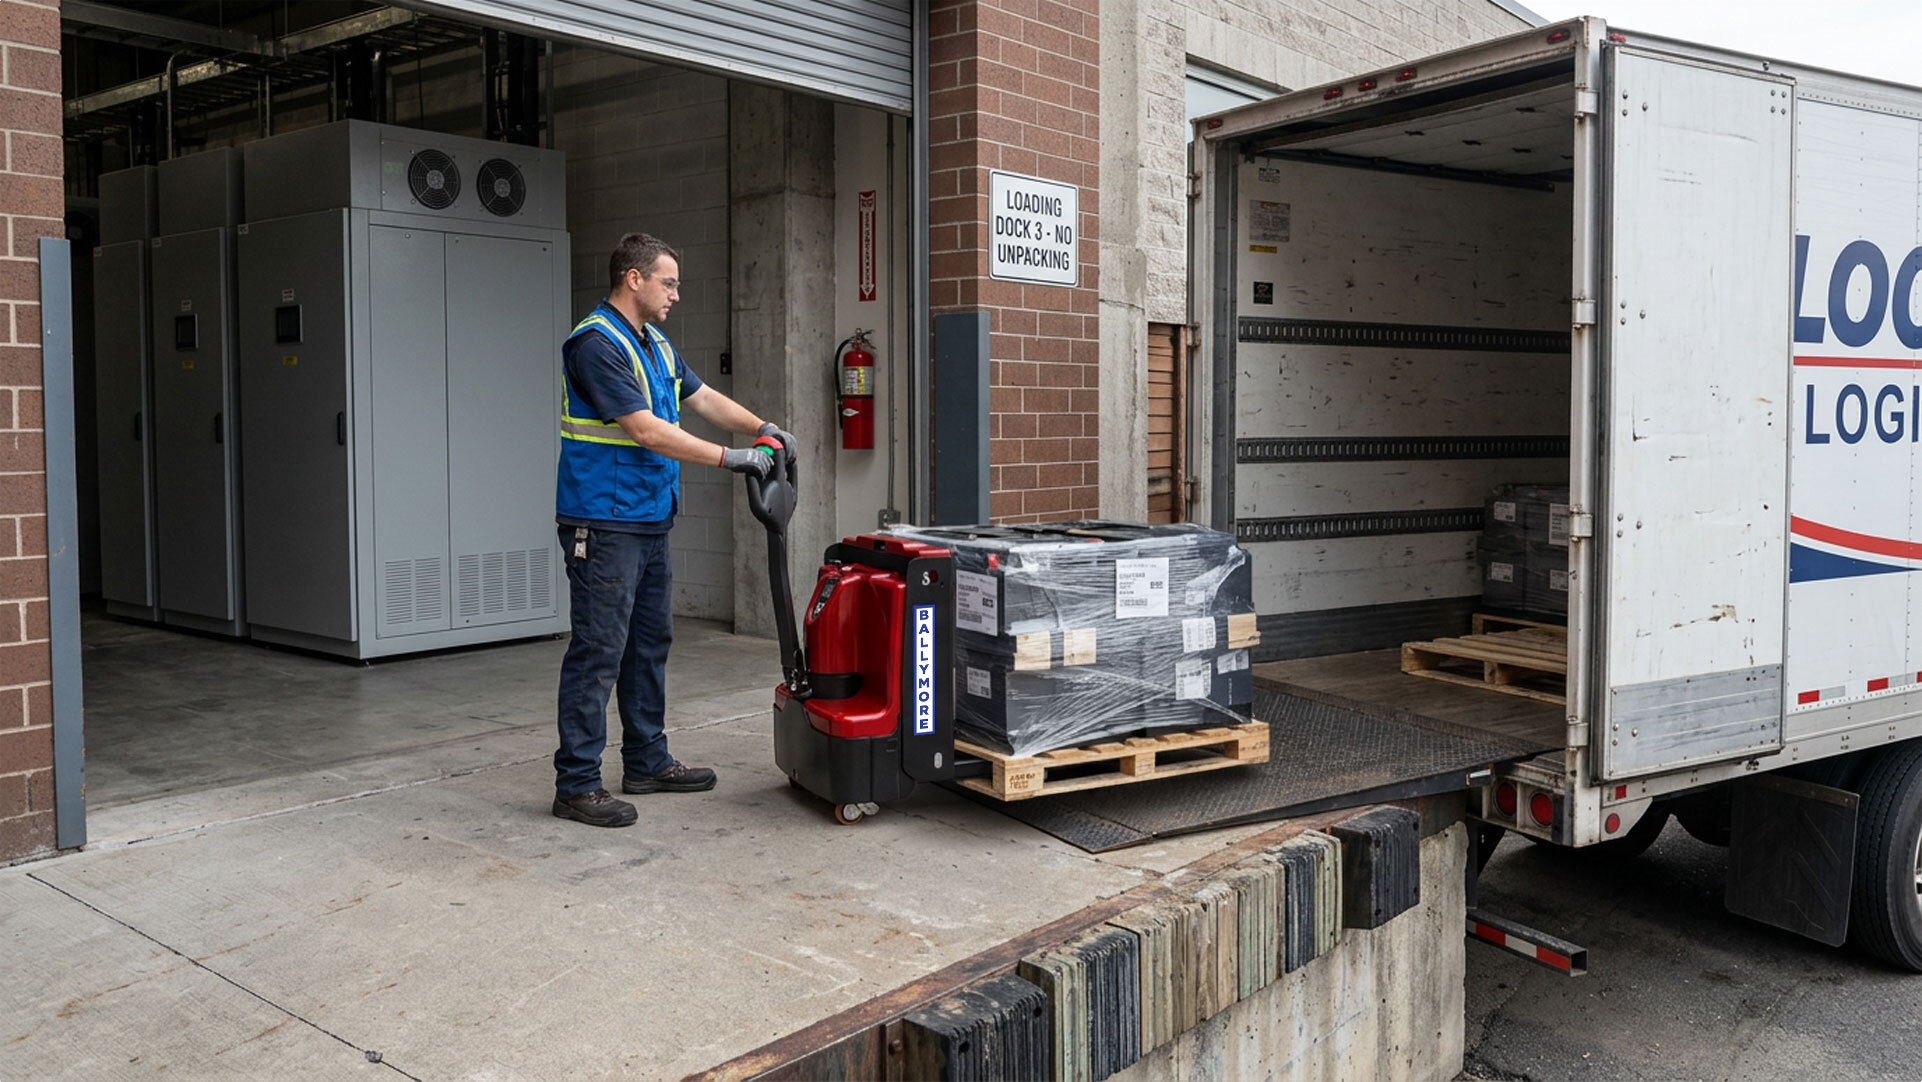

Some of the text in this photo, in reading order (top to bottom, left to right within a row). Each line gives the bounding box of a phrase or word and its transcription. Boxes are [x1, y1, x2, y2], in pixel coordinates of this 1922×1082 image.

[1007, 190, 1062, 217] LOADING
[996, 215, 1031, 239] DOCK
[1034, 221, 1043, 241] 3
[1055, 224, 1072, 245] NO
[998, 243, 1070, 271] UNPACKING
[1805, 383, 1920, 445] LOGI
[918, 609, 930, 730] BALLYMORE
